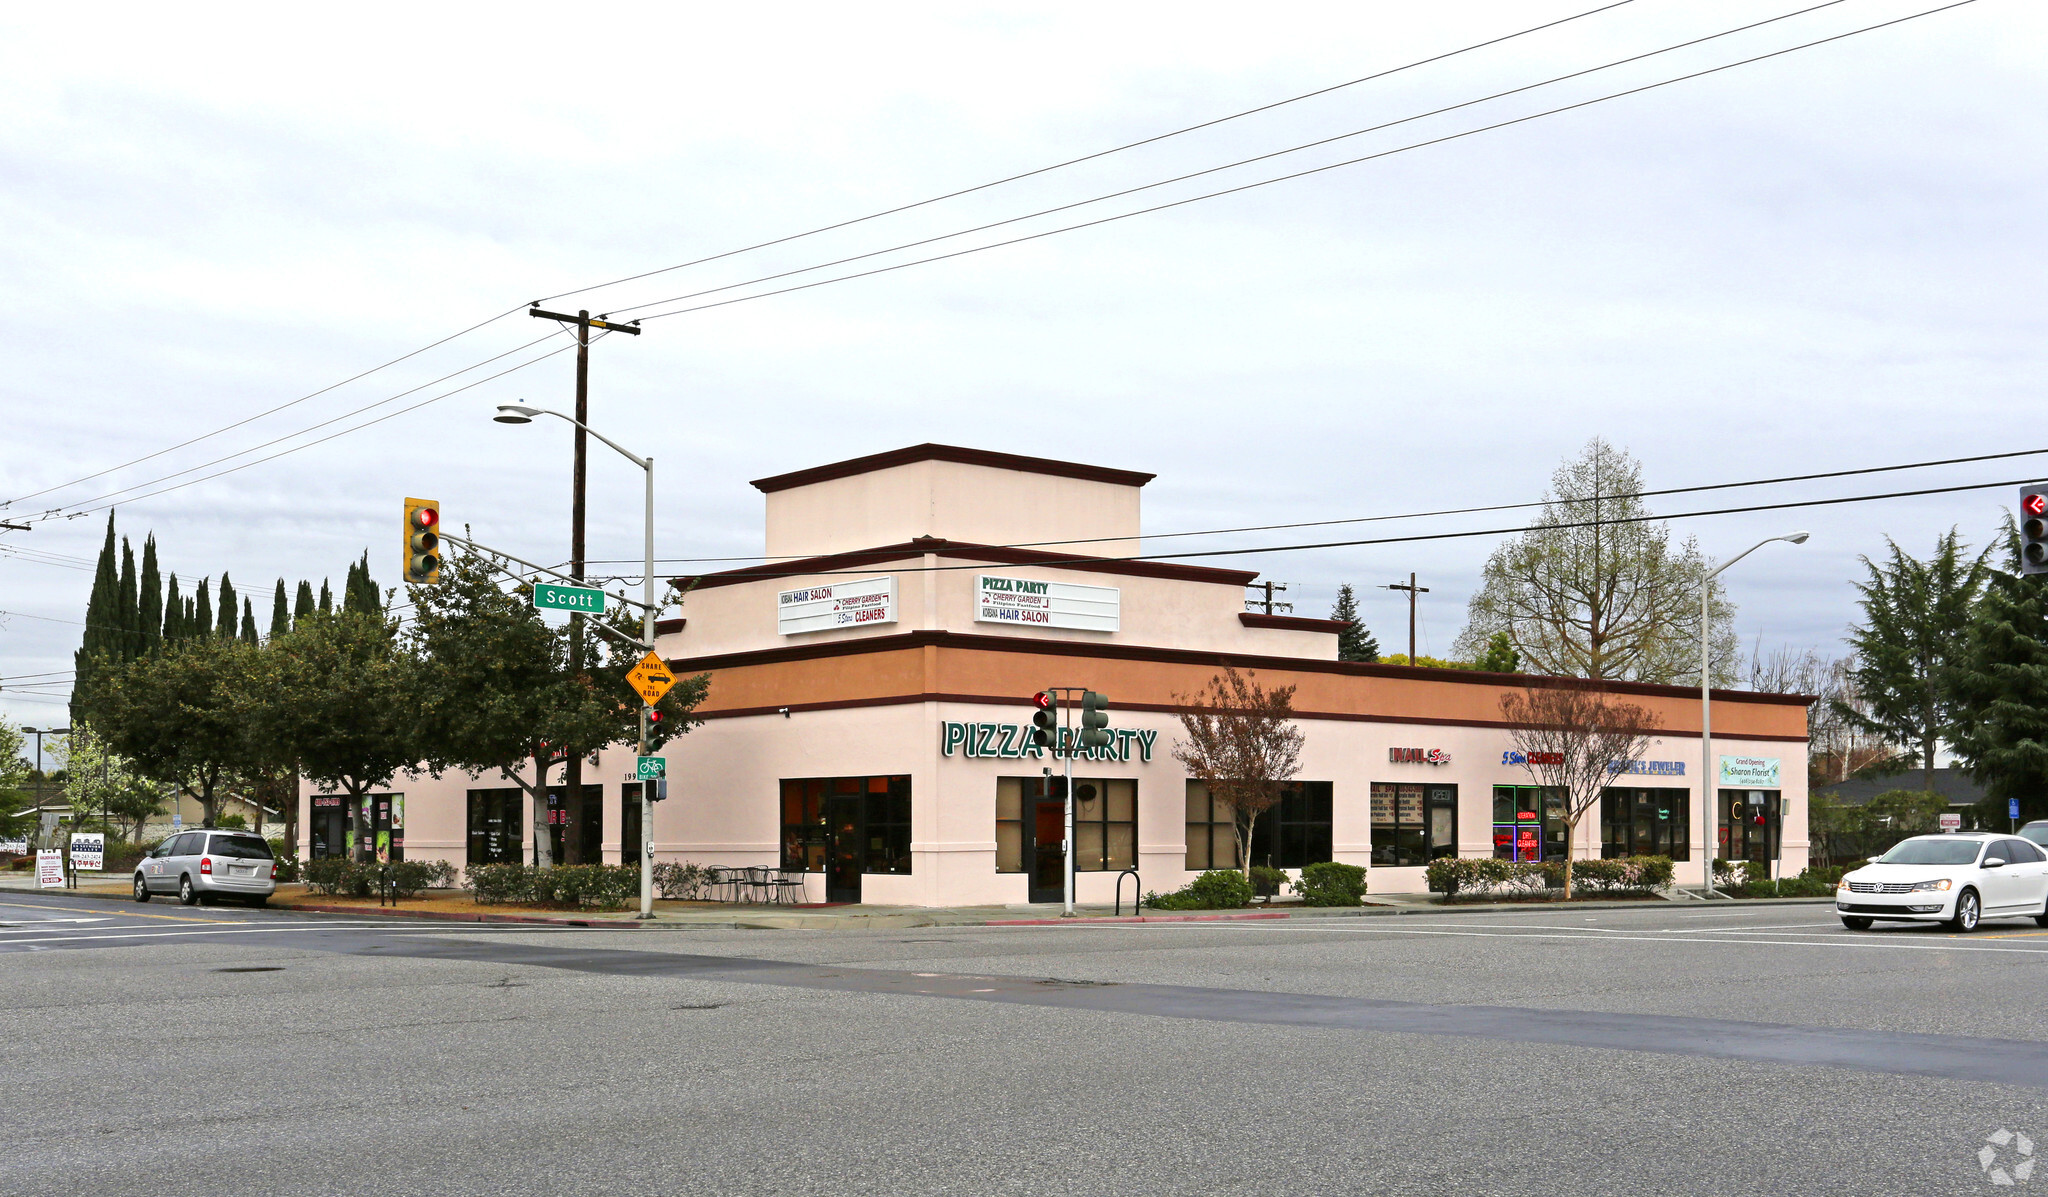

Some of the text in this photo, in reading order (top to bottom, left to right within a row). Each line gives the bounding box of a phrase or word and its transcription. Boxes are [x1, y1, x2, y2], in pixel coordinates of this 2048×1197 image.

[982, 577, 1049, 594] PIZZA PARTY
[546, 591, 593, 607] Scott
[793, 591, 809, 602] HAIR
[810, 588, 832, 601] SALON
[841, 594, 882, 606] CHERRY GARDEN
[993, 593, 1041, 604] CHERRY GARDEN
[855, 608, 885, 622] CLEANERS
[999, 609, 1020, 621] HAIR
[1021, 610, 1049, 623] SALON
[641, 662, 662, 671] SHARE
[642, 689, 660, 697] ROAD
[943, 721, 1044, 758] PIZZA
[1390, 747, 1452, 766] NAIL Spa
[1502, 751, 1509, 765] 5
[1748, 759, 1766, 767] Opening
[1731, 767, 1770, 777] Sharon Florist
[1522, 831, 1533, 840] DRY
[1517, 839, 1538, 848] CLEANERS
